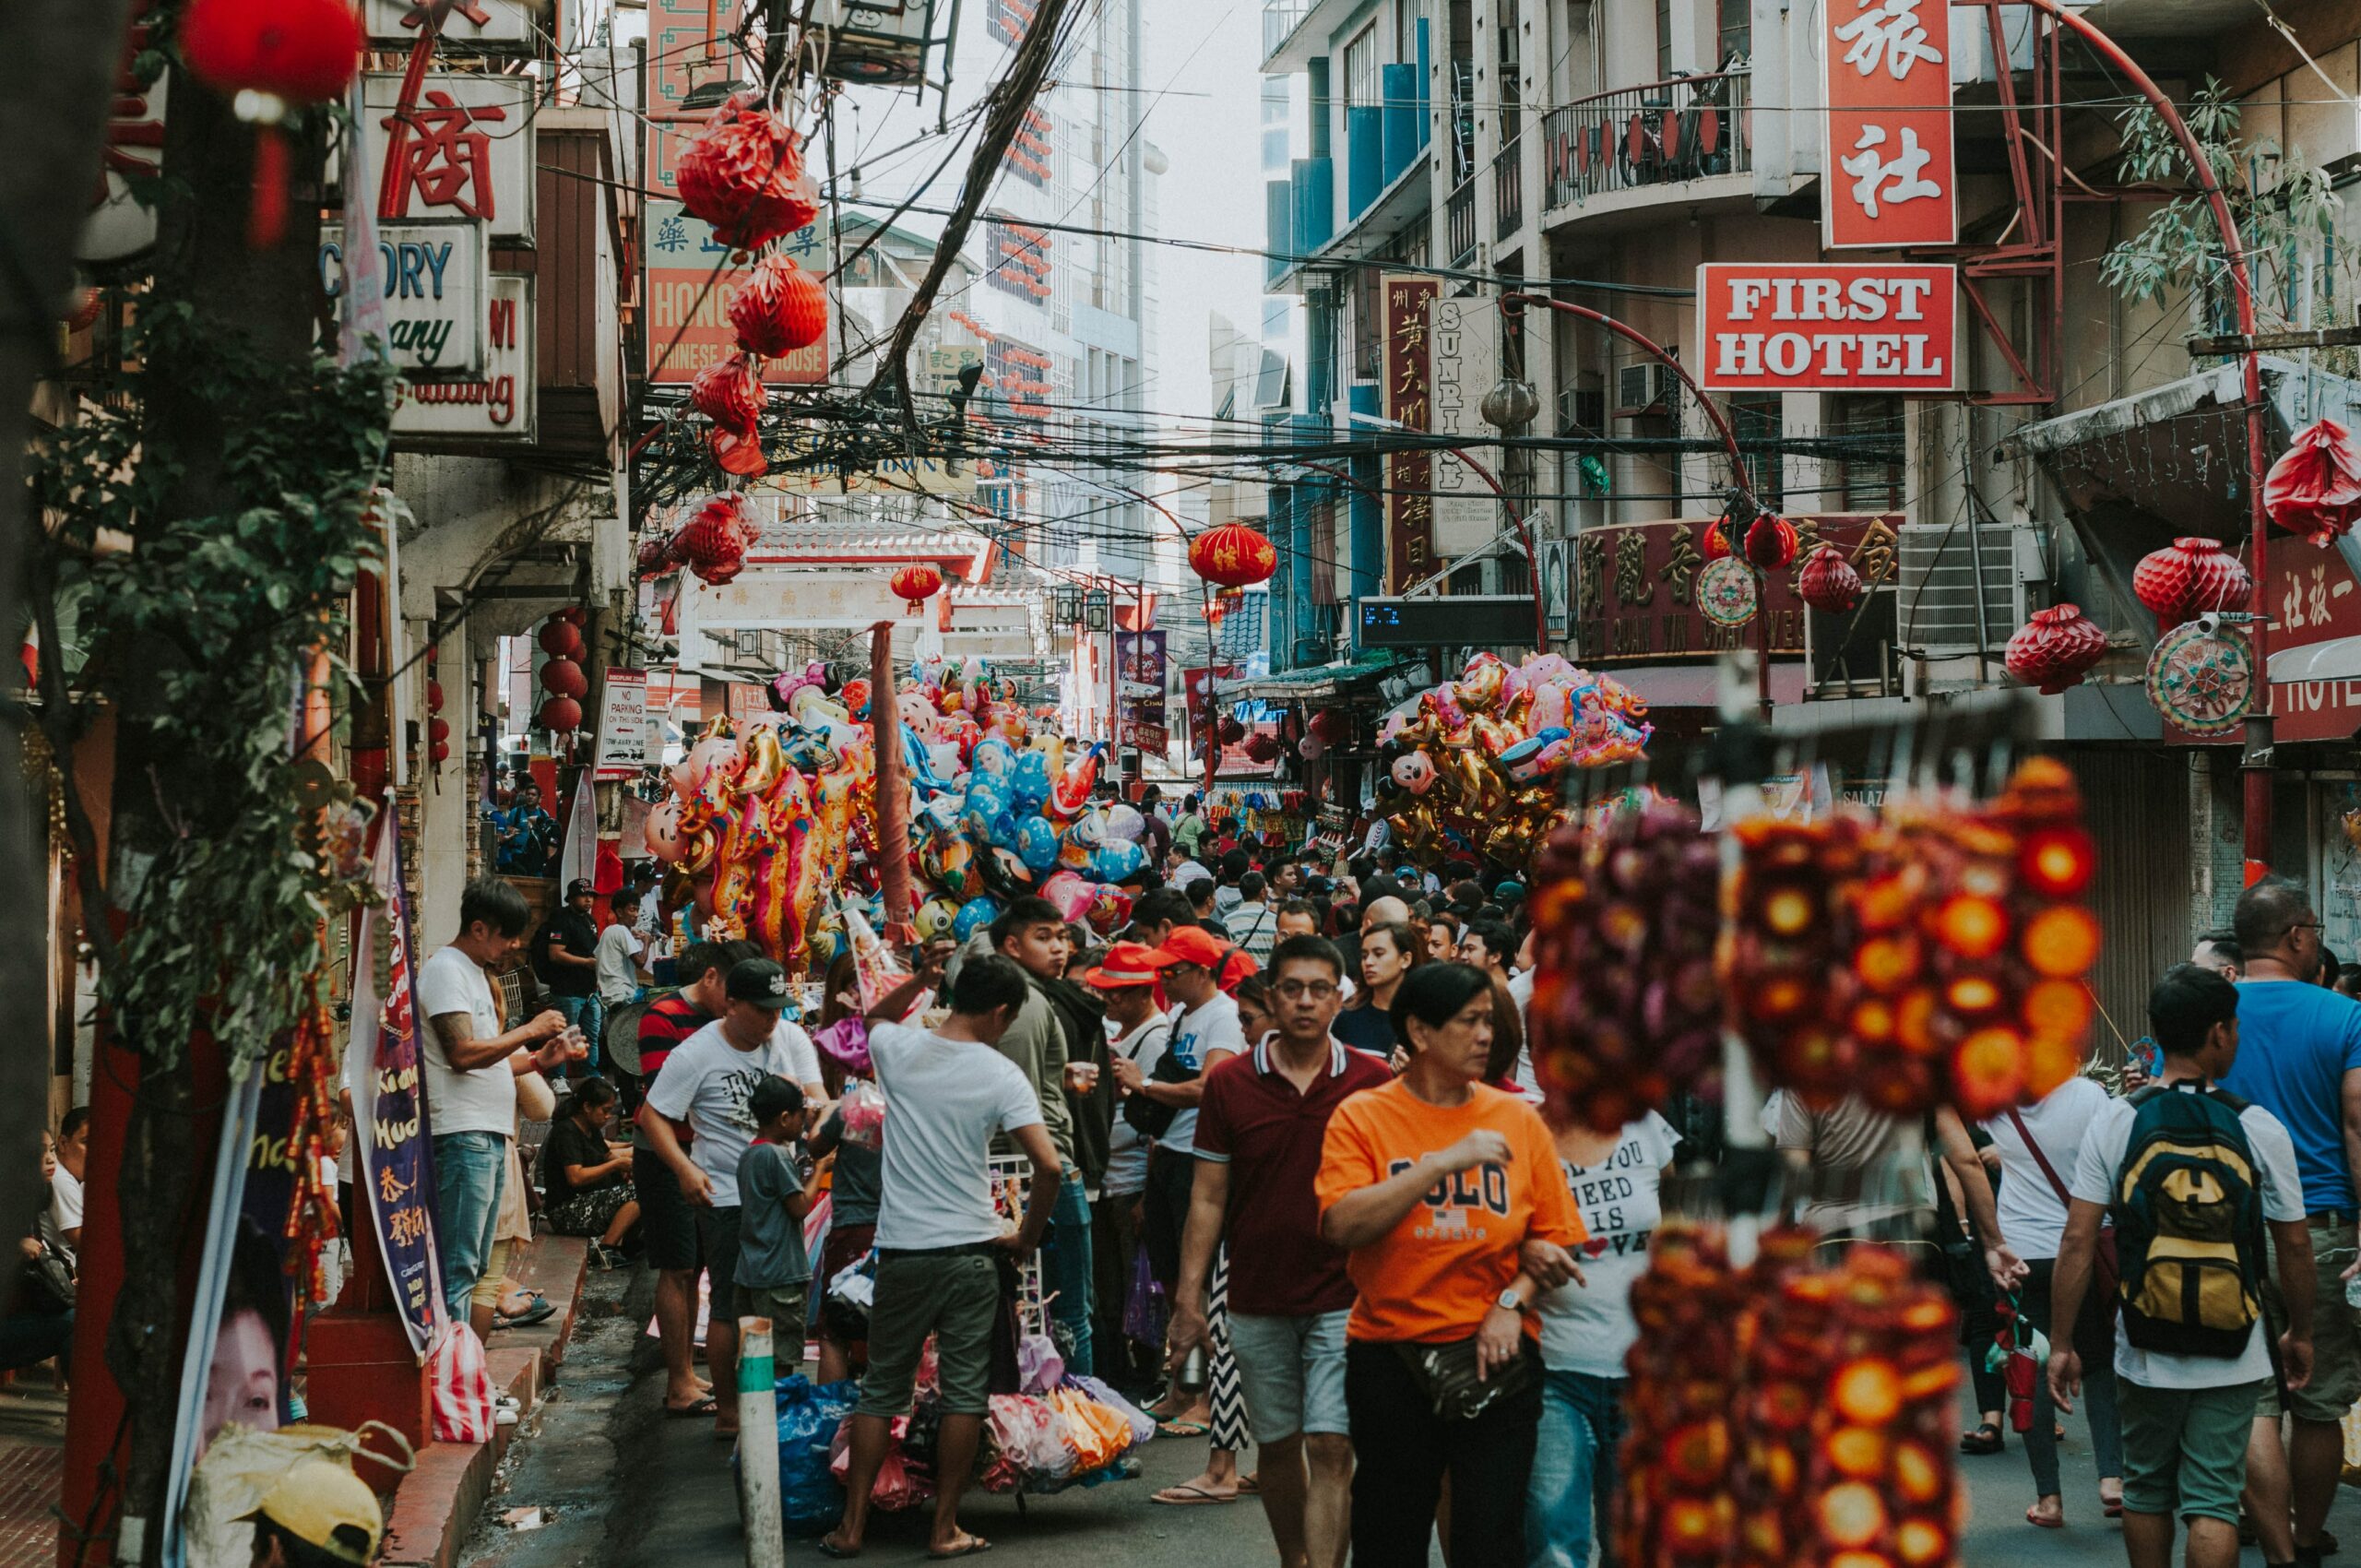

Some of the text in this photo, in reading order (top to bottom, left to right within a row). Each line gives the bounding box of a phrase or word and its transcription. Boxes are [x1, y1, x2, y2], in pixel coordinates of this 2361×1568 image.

[1727, 278, 1930, 320] FIRST
[654, 342, 718, 370] CHINESE
[1715, 332, 1942, 376] HOTEL
[611, 703, 643, 714] PARKING
[622, 691, 632, 701] NO
[1591, 1206, 1624, 1233] IS
